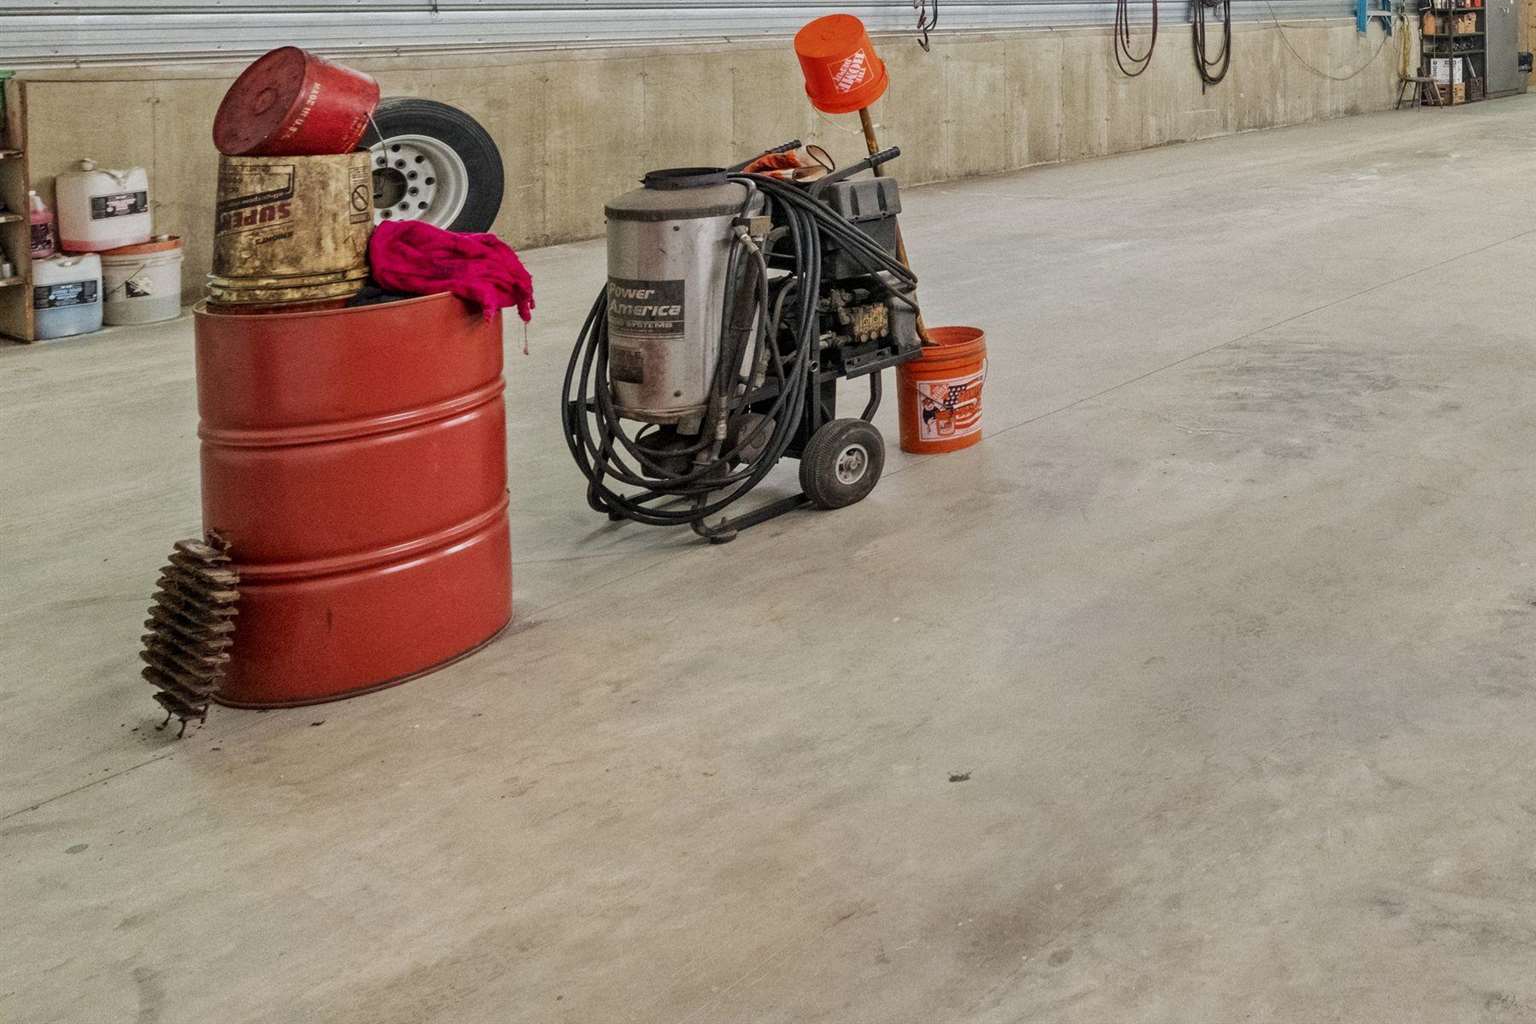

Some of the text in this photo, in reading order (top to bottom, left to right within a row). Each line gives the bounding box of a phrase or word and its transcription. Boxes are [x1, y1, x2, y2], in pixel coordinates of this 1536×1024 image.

[308, 81, 321, 106] MADE
[302, 107, 312, 118] IN
[608, 282, 656, 299] Power
[608, 299, 682, 316] America
